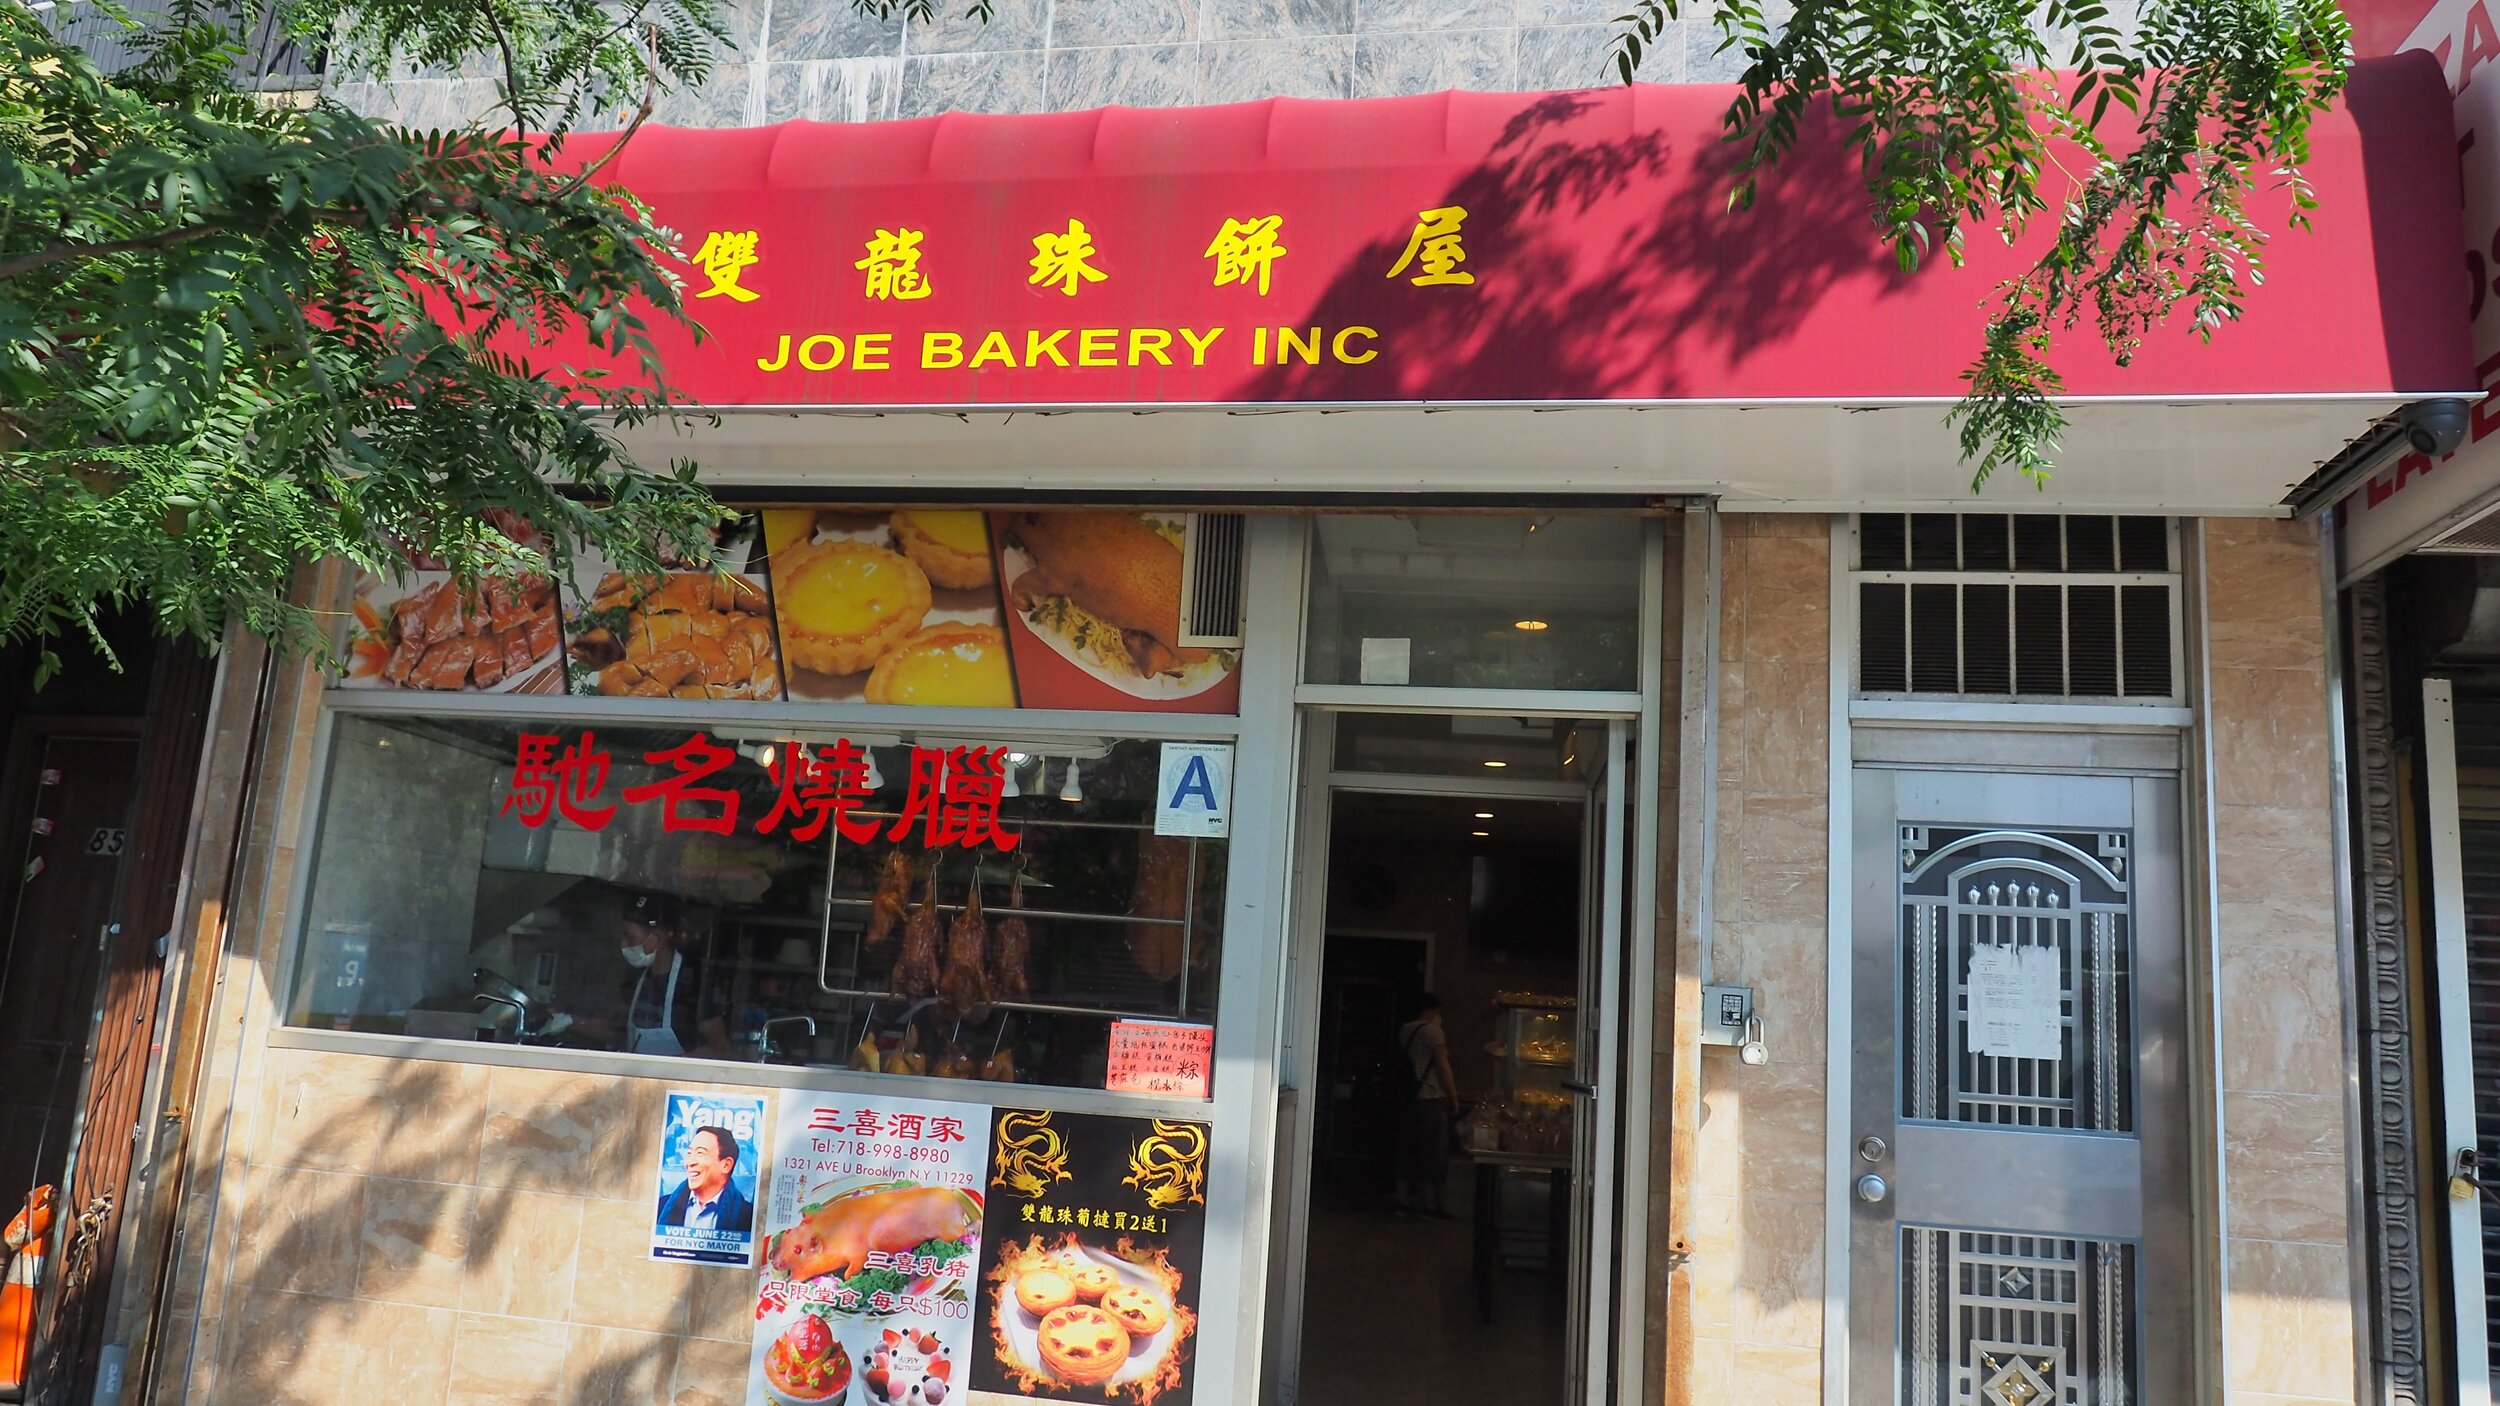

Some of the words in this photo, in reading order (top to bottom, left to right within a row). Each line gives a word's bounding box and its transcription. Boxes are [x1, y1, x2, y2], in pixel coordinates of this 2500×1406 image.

[691, 205, 1477, 303] 雙龍珠餅屋
[757, 333, 892, 372] JOE
[921, 327, 1225, 369] BAKERY
[1253, 326, 1380, 365] INC
[500, 731, 1021, 852] 馳名燒臘
[1169, 755, 1218, 811] A
[89, 829, 125, 853] 85
[677, 1099, 755, 1140] Yang
[807, 1107, 966, 1143] 三喜酒家
[811, 1137, 950, 1164] Tel:718-998-8980
[784, 1157, 812, 1170] 1321
[816, 1161, 839, 1173] AVE
[842, 1163, 852, 1174] U
[855, 1163, 906, 1181] Brooklyn
[909, 1168, 931, 1181] N.Y
[936, 1170, 974, 1185] 11229
[665, 1226, 691, 1237] VOTE
[692, 1229, 719, 1240] JUNE
[1020, 1202, 1168, 1234] 雙龍珠葡撻買2送1
[665, 1238, 683, 1247] FOR
[685, 1239, 705, 1249] NYC
[706, 1241, 741, 1252] MAYOR
[864, 1250, 970, 1278] 三喜乳猪
[764, 1280, 862, 1307] 只限堂食
[870, 1290, 970, 1320] 每只$100
